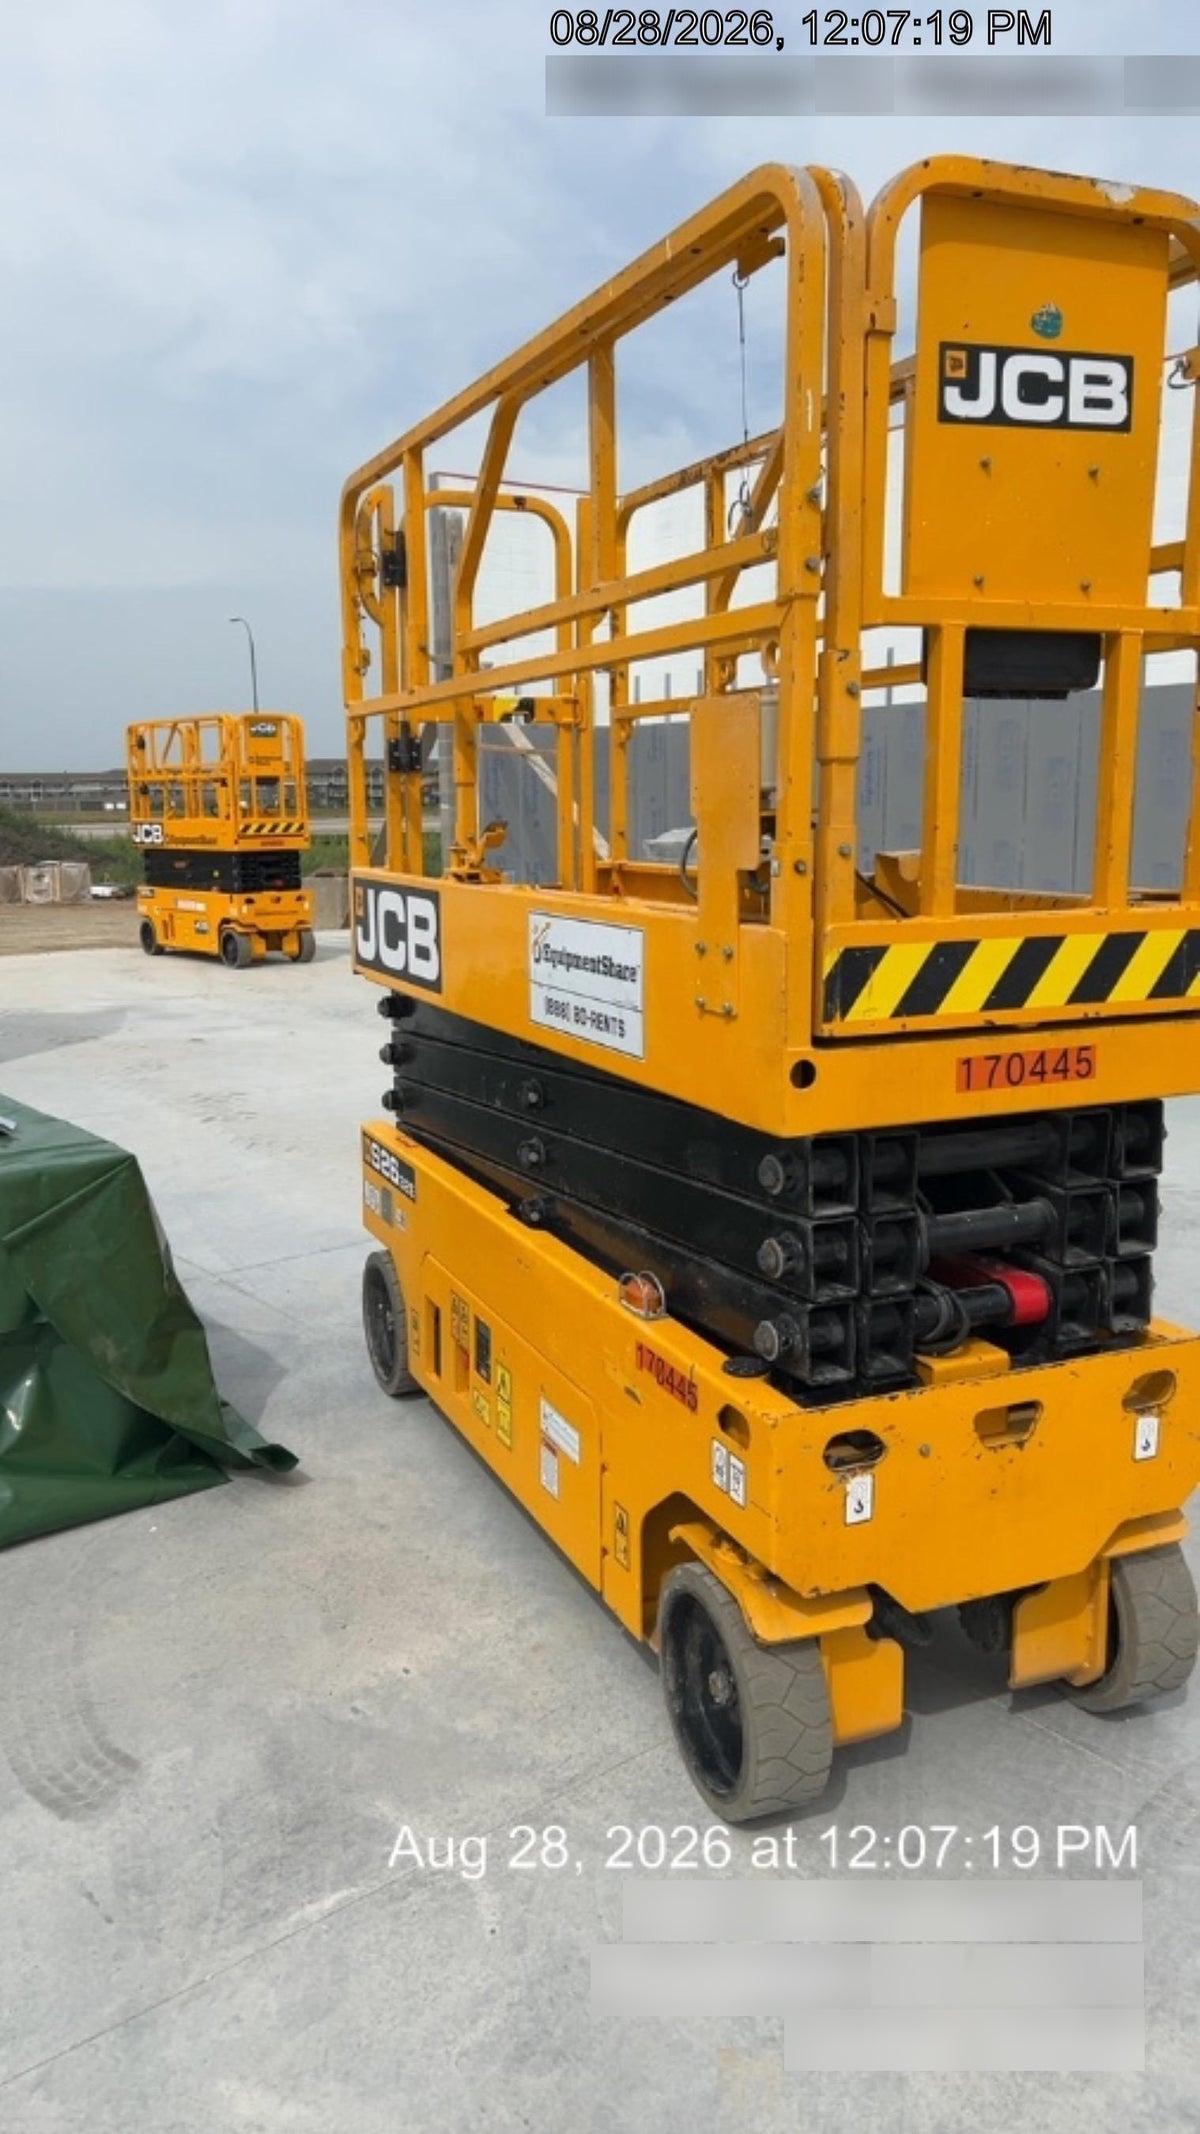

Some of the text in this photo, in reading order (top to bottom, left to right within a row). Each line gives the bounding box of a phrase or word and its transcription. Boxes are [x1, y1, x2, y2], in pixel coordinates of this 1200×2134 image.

[943, 351, 1129, 425] JCB
[132, 824, 163, 843] JCB
[357, 887, 439, 982] JCB
[543, 943, 637, 983] EquipmentShare
[961, 1046, 1093, 1090] 170445
[635, 1342, 698, 1412] 170445
